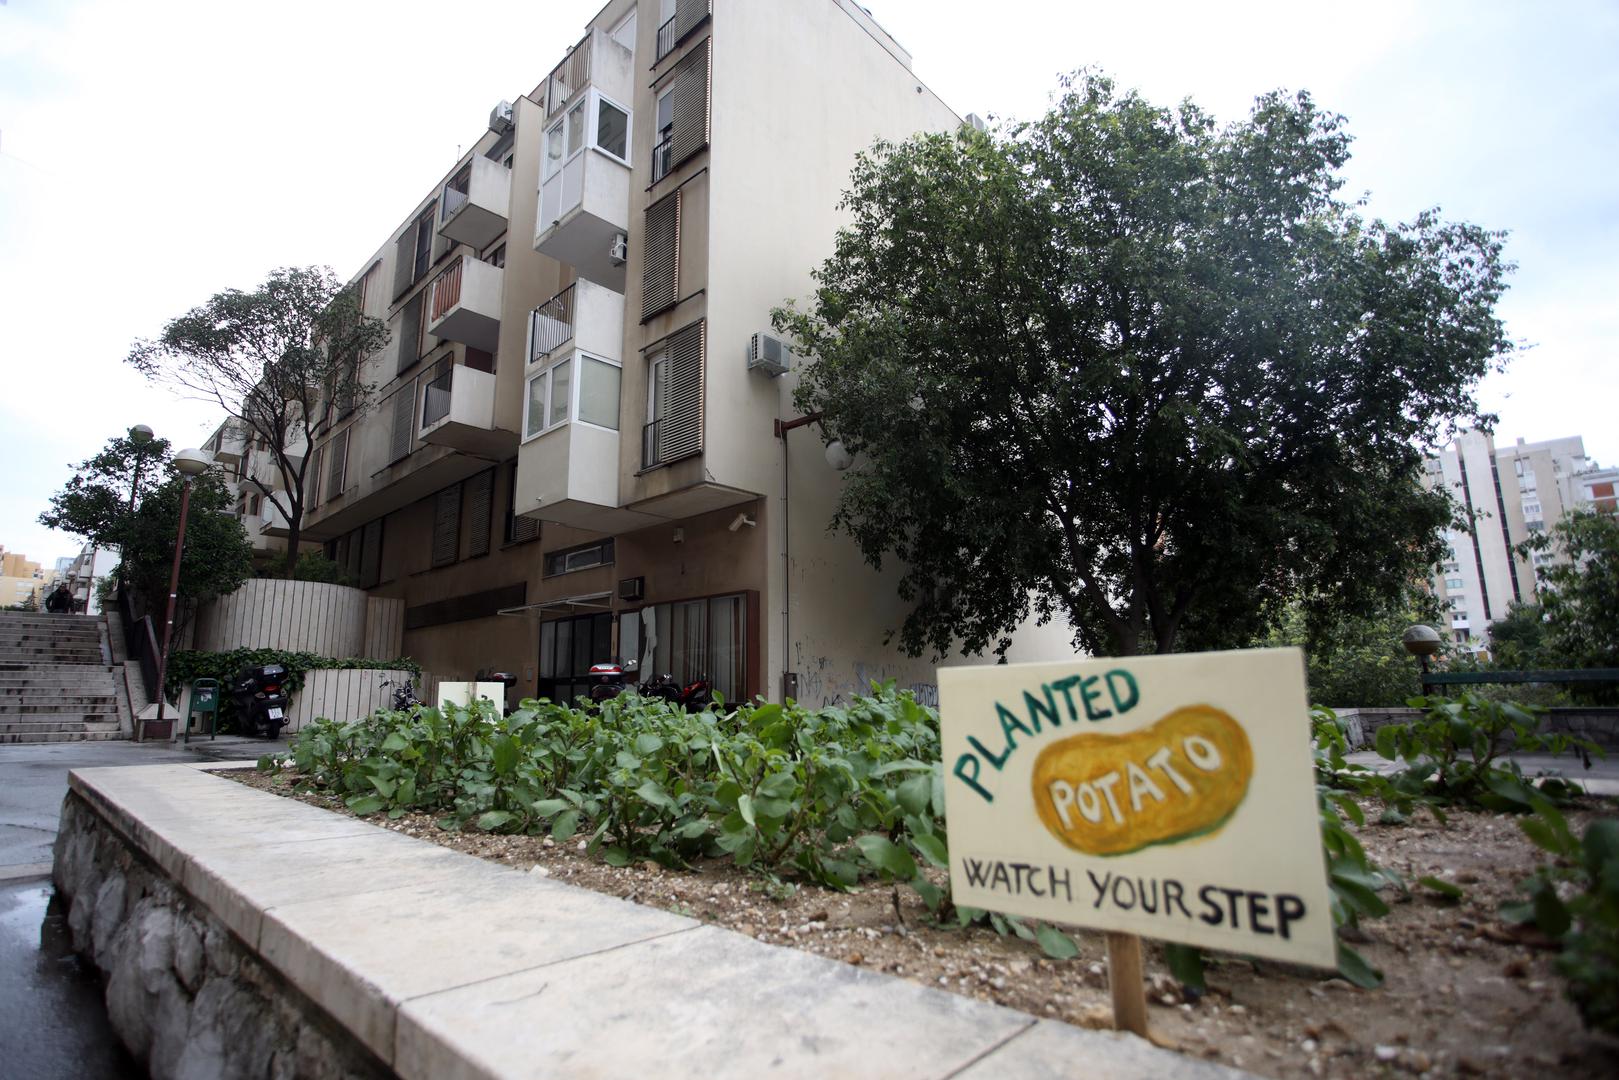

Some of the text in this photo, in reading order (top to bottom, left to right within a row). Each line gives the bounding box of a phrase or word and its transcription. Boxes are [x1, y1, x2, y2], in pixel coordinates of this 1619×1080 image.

[954, 669, 1140, 803] PLANTED
[1050, 734, 1223, 830] POTATO
[962, 857, 1305, 939] WATCH YOUR STEP
